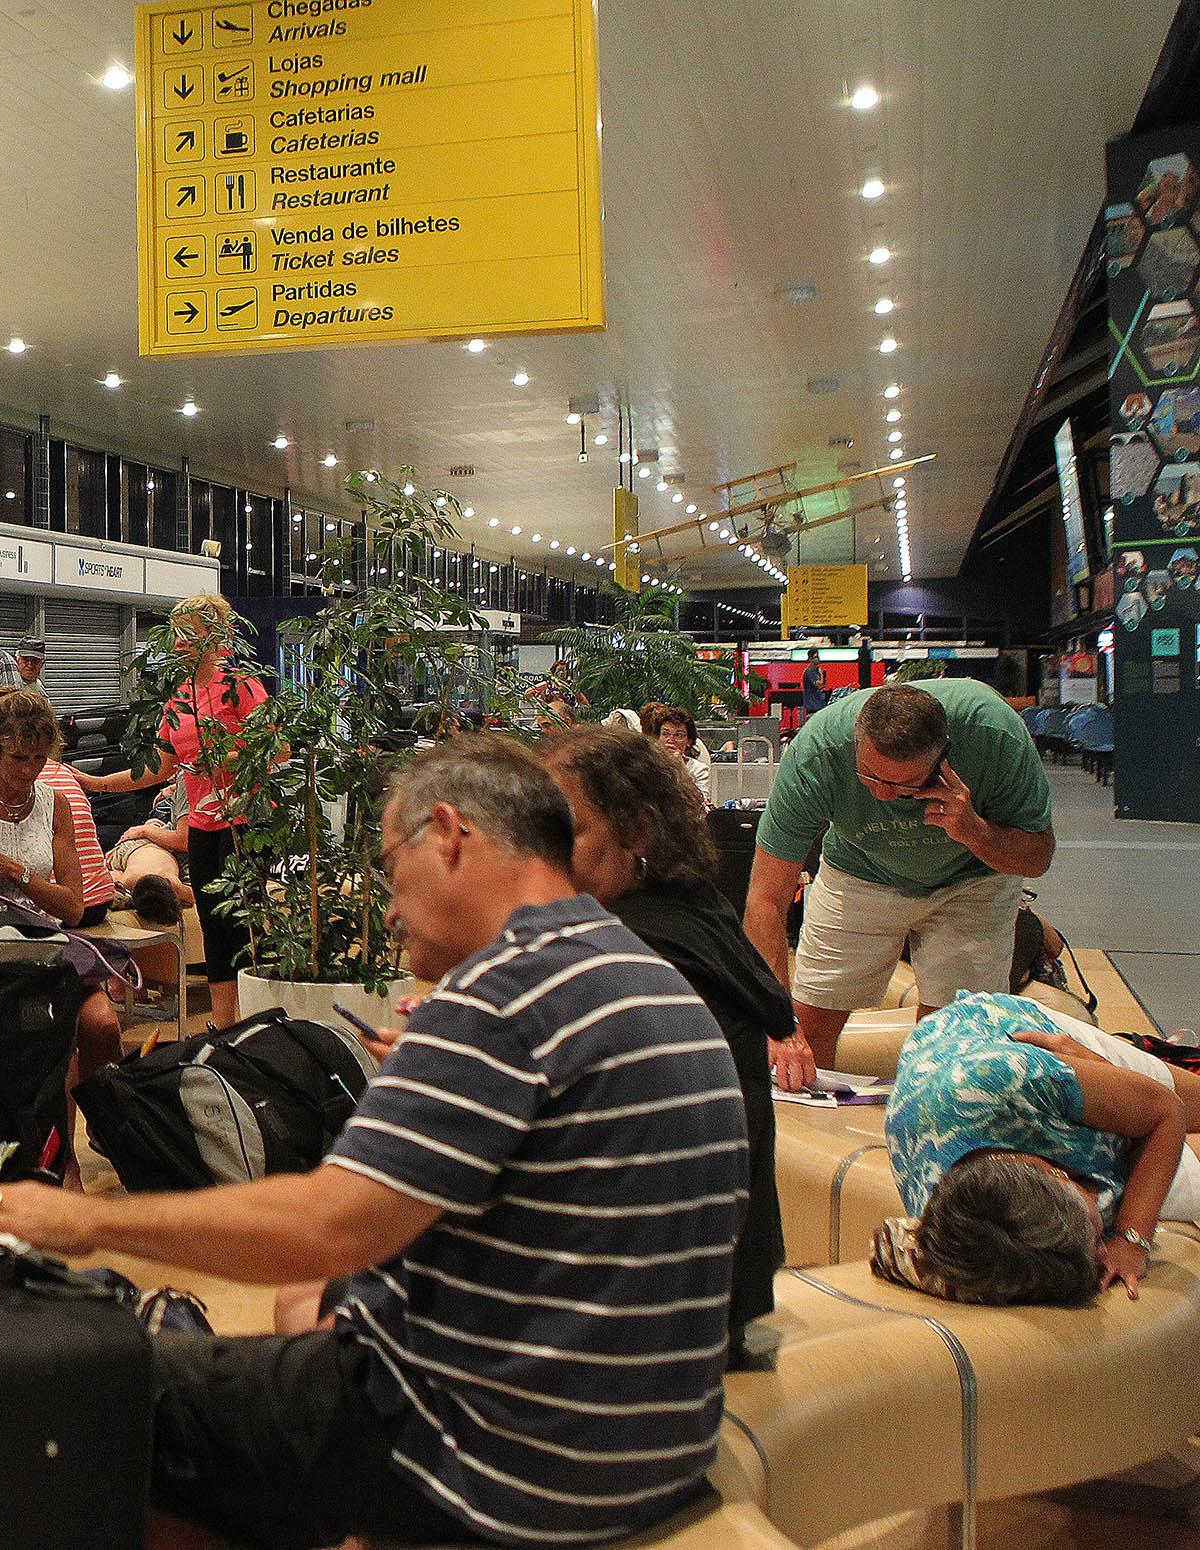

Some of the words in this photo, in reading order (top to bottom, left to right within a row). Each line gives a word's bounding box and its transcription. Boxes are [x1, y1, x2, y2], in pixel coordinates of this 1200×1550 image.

[268, 18, 347, 43] Arrivals
[269, 53, 323, 74] Lojas
[270, 74, 373, 98] Shopping
[380, 65, 428, 87] mall
[270, 103, 375, 128] Cafetarias
[271, 129, 380, 154] Cafeterias
[271, 157, 396, 184] Restaurante
[271, 184, 391, 210] Restaurant
[271, 225, 334, 246] Venda
[342, 222, 369, 240] de
[377, 215, 460, 238] bilhetes
[272, 250, 335, 271] Ticket
[342, 246, 400, 266] sales
[273, 279, 357, 302] Partidas
[274, 306, 394, 329] Departures
